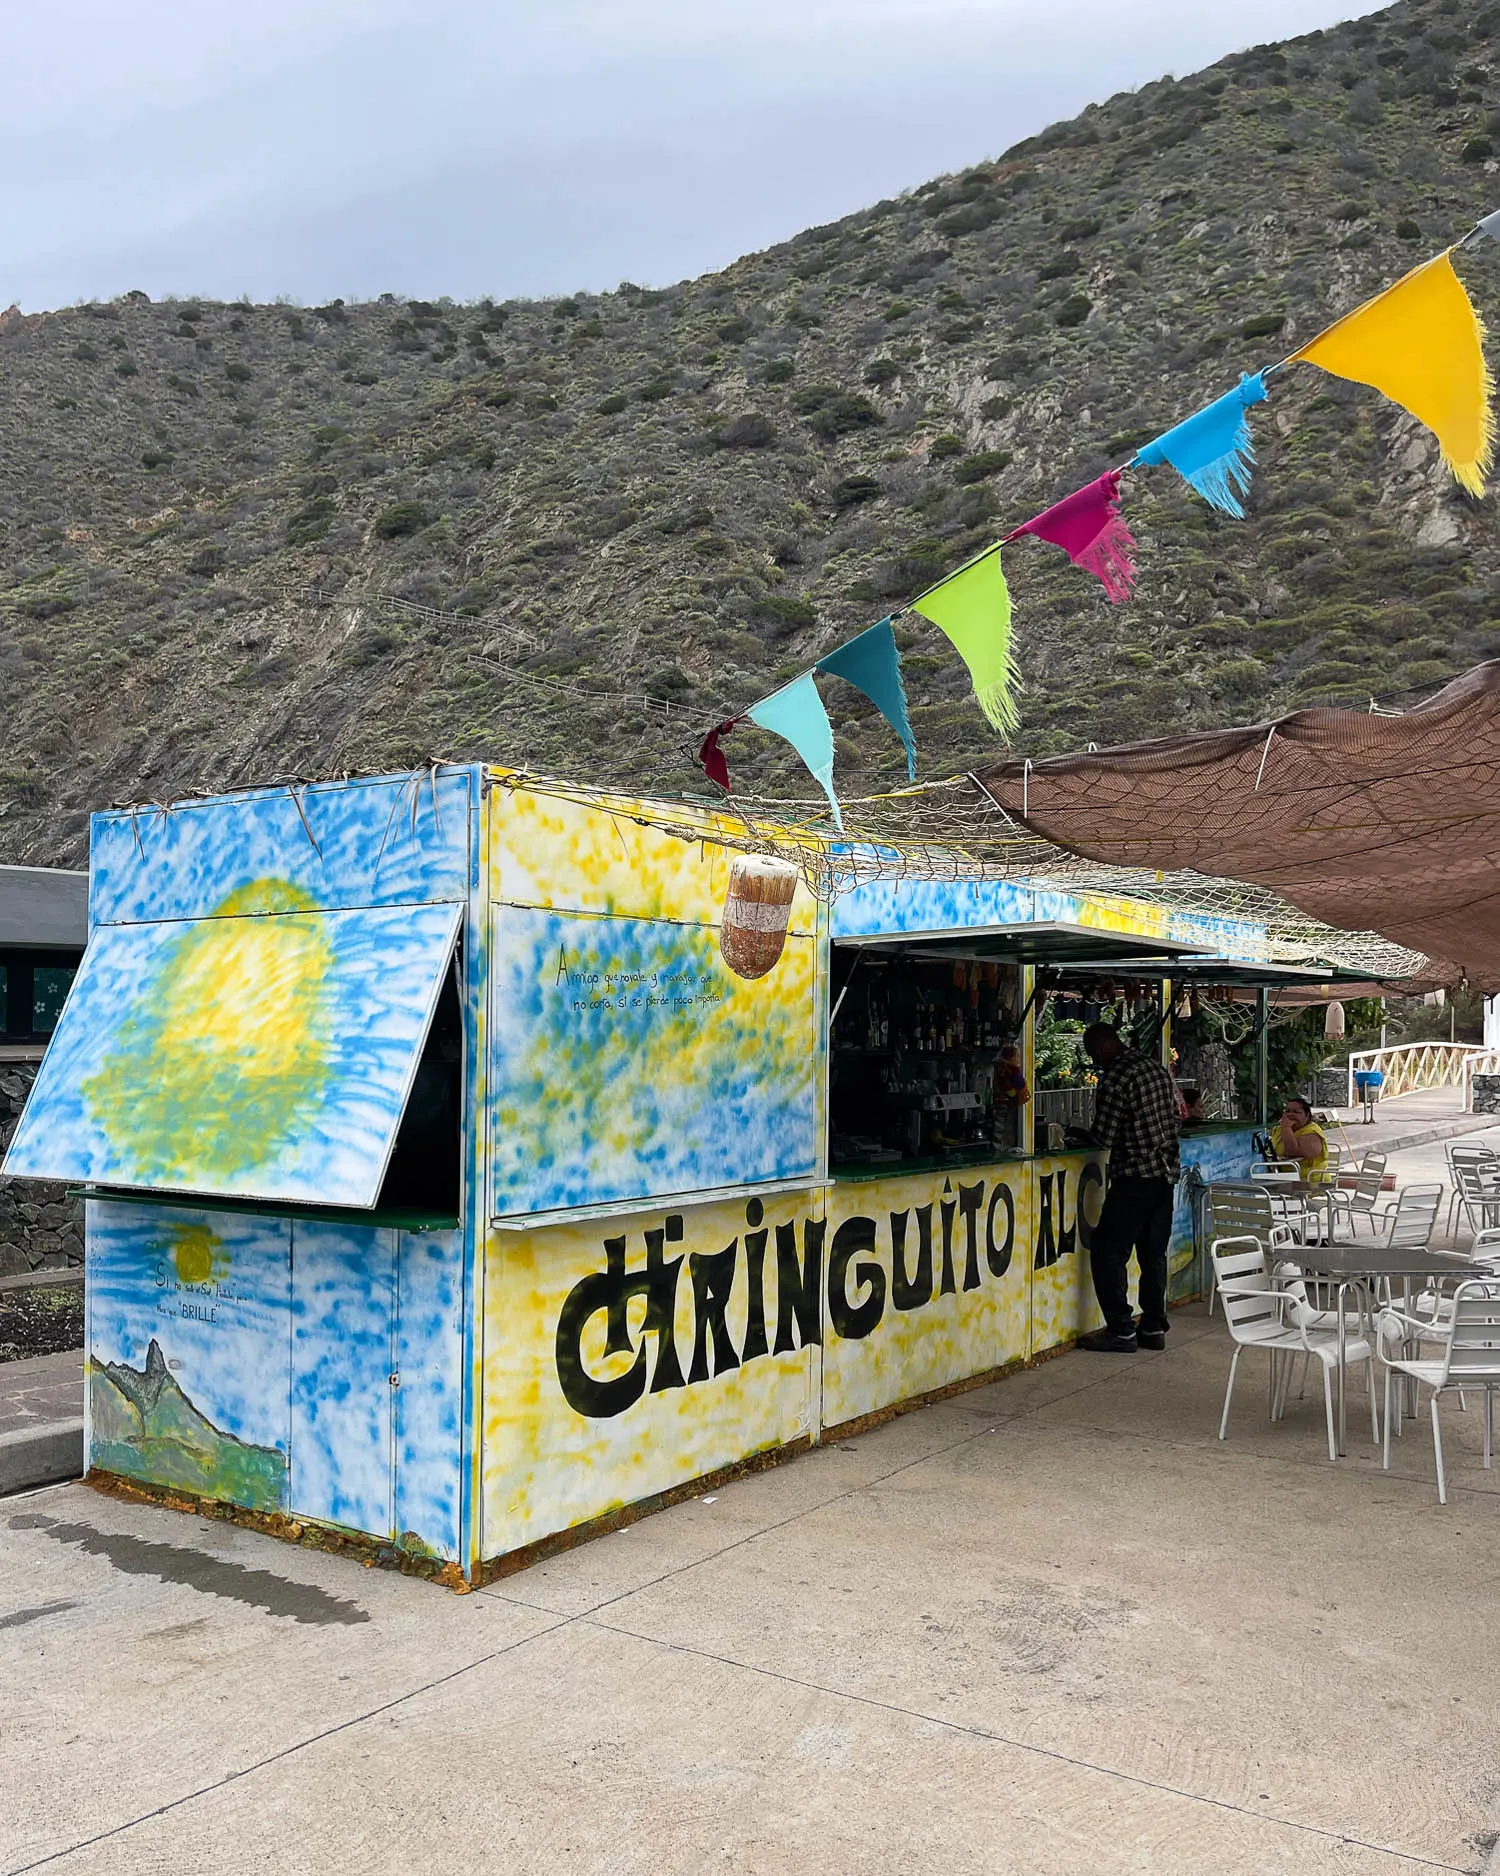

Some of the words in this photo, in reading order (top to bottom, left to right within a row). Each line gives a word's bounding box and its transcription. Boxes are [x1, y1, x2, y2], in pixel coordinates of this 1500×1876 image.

[556, 943, 599, 994] Amigo
[604, 974, 619, 993] que
[649, 973, 658, 988] y
[700, 975, 712, 992] que
[573, 1000, 587, 1011] no
[618, 995, 627, 1008] si
[631, 998, 642, 1007] se
[645, 994, 669, 1013] pierde
[673, 997, 693, 1012] poco
[695, 993, 721, 1009] importa
[1033, 1161, 1106, 1272] ALC
[155, 1262, 169, 1289] Si
[174, 1283, 182, 1291] no
[178, 1300, 221, 1323] "BRILLE"
